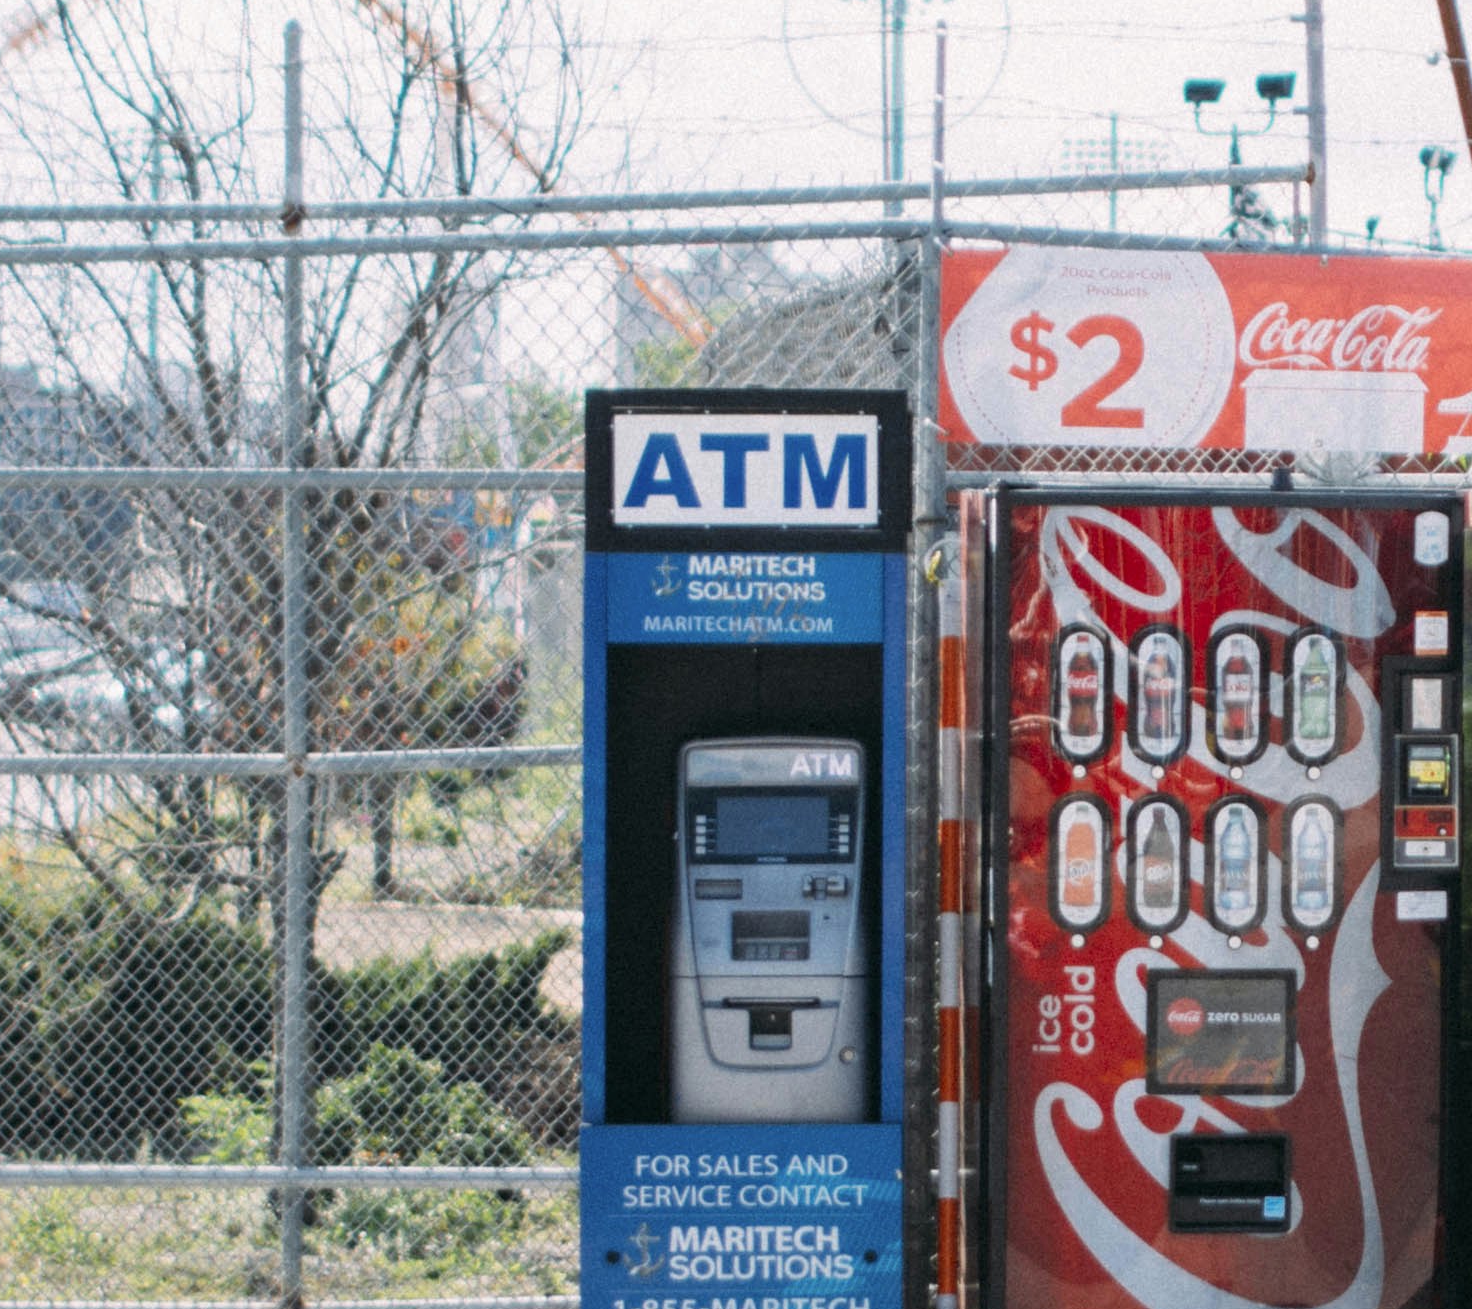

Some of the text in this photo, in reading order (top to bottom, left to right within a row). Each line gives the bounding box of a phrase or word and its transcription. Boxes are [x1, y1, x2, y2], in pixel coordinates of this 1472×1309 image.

[1060, 266, 1172, 281] 20oz Coca-Cola
[1086, 285, 1149, 297] Products
[1239, 301, 1443, 371] Coca-Cola
[1007, 309, 1145, 429] $2
[622, 433, 867, 509] ATM
[687, 555, 816, 577] MARITECH
[687, 581, 826, 601] SOLUTIONS
[643, 615, 834, 633] MARITECHATM.COM
[789, 753, 853, 776] ATM
[1063, 965, 1095, 1055] cold
[1207, 1011, 1240, 1023] zero
[1241, 1012, 1281, 1023] SUGAR
[1032, 994, 1061, 1053] ice
[635, 1154, 849, 1177] FOR SALES AND
[622, 1184, 869, 1208] SERVICE CONTACT
[668, 1225, 840, 1252] MARITECH
[668, 1254, 854, 1281] SOLUTIONS
